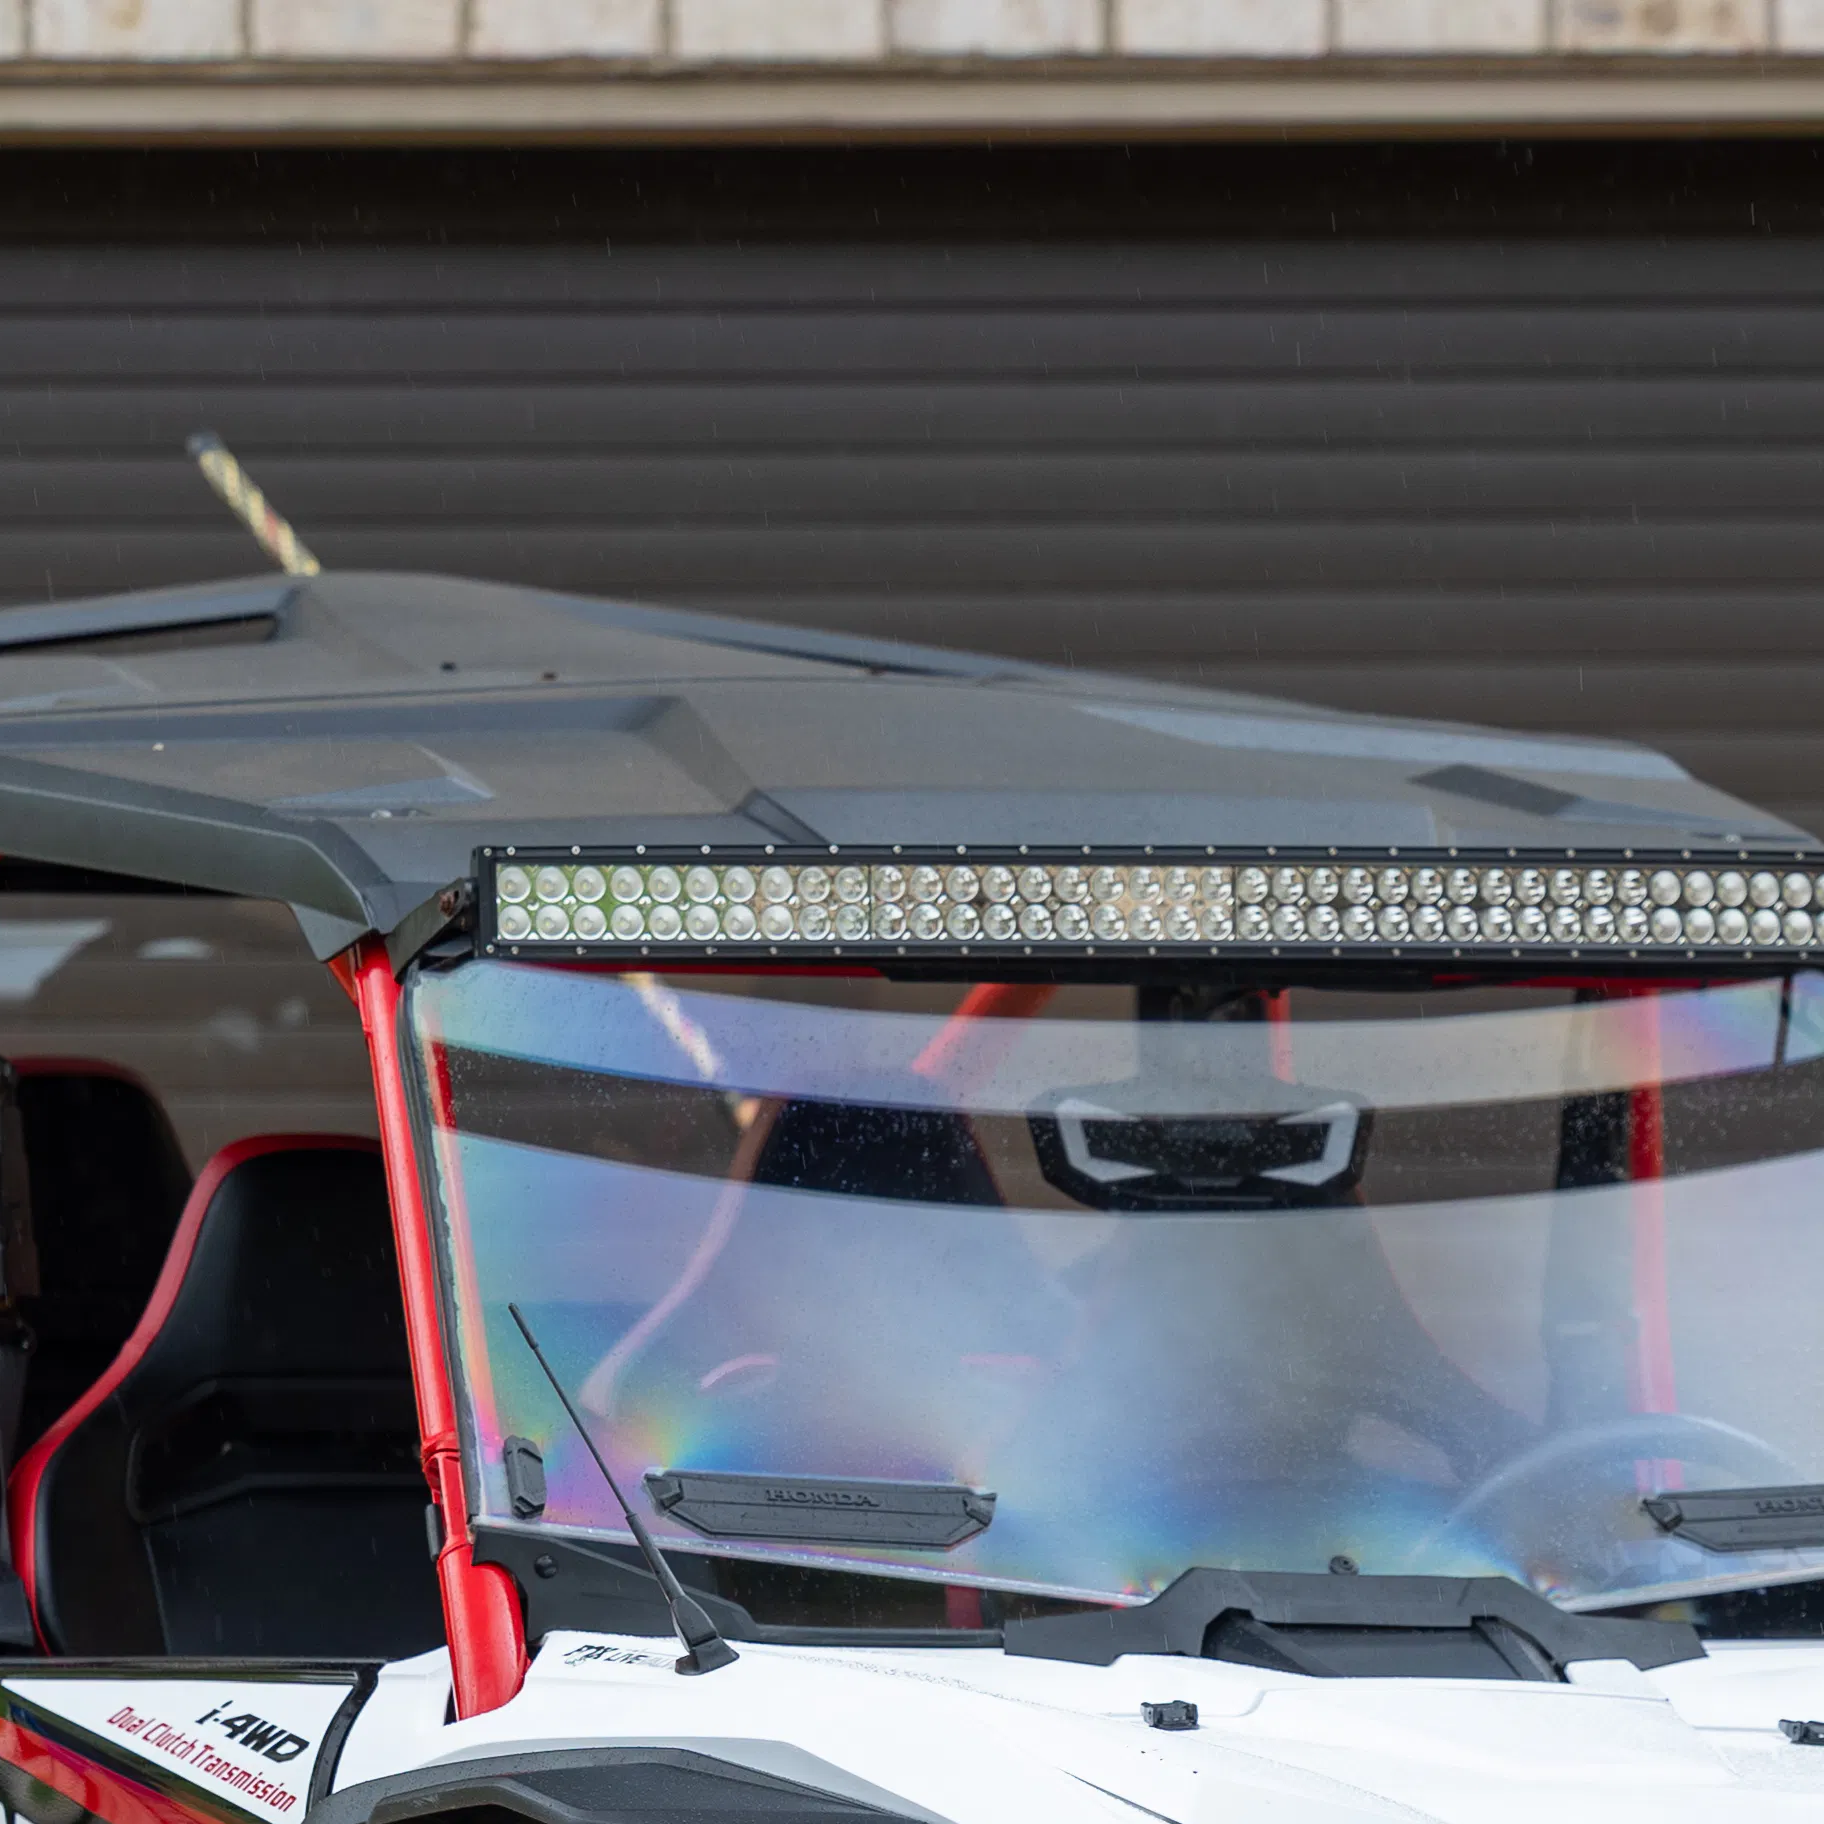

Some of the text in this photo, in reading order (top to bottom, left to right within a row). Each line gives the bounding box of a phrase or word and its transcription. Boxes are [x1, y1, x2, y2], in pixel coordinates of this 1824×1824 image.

[765, 1488, 880, 1508] HONDA
[106, 1706, 297, 1812] Dual Clutch Transmission
[195, 1700, 310, 1763] i-4WD
